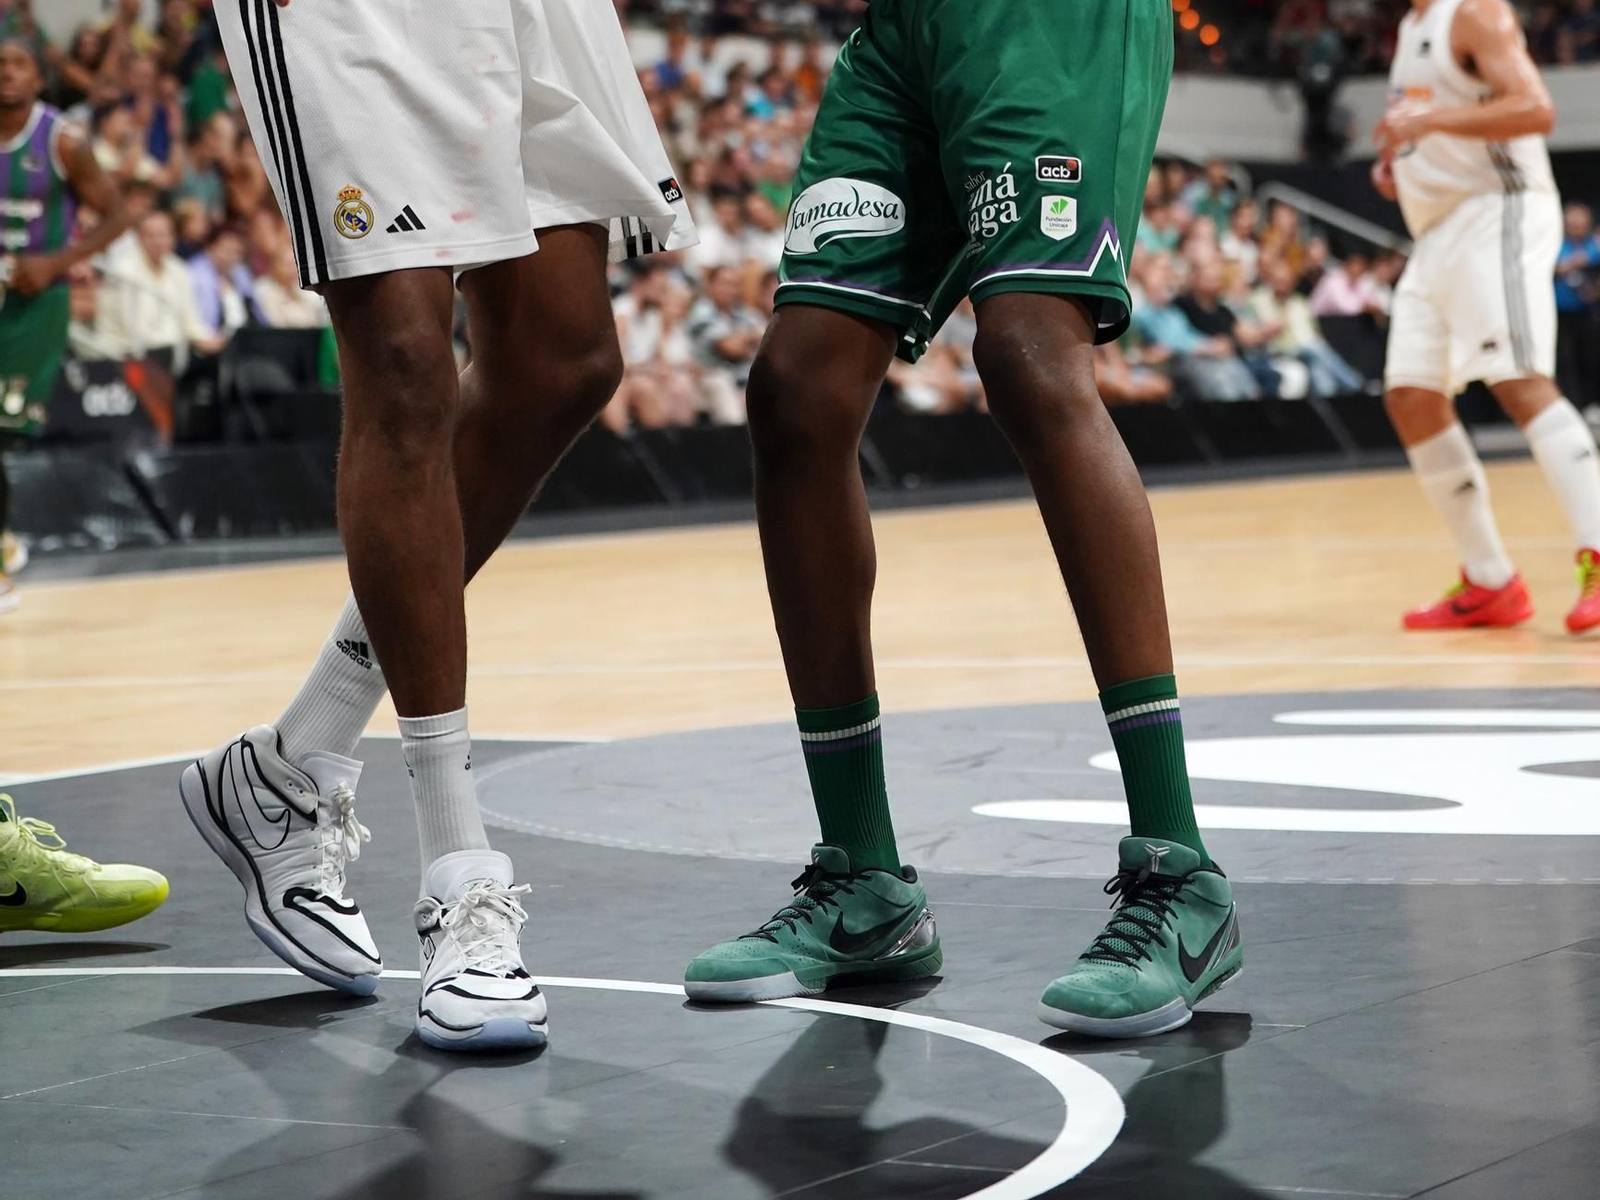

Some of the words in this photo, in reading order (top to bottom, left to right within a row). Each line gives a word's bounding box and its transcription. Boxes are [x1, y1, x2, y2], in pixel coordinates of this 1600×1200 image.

[1041, 165, 1071, 178] acb
[784, 184, 899, 242] famadesa
[336, 640, 373, 670] adidas
